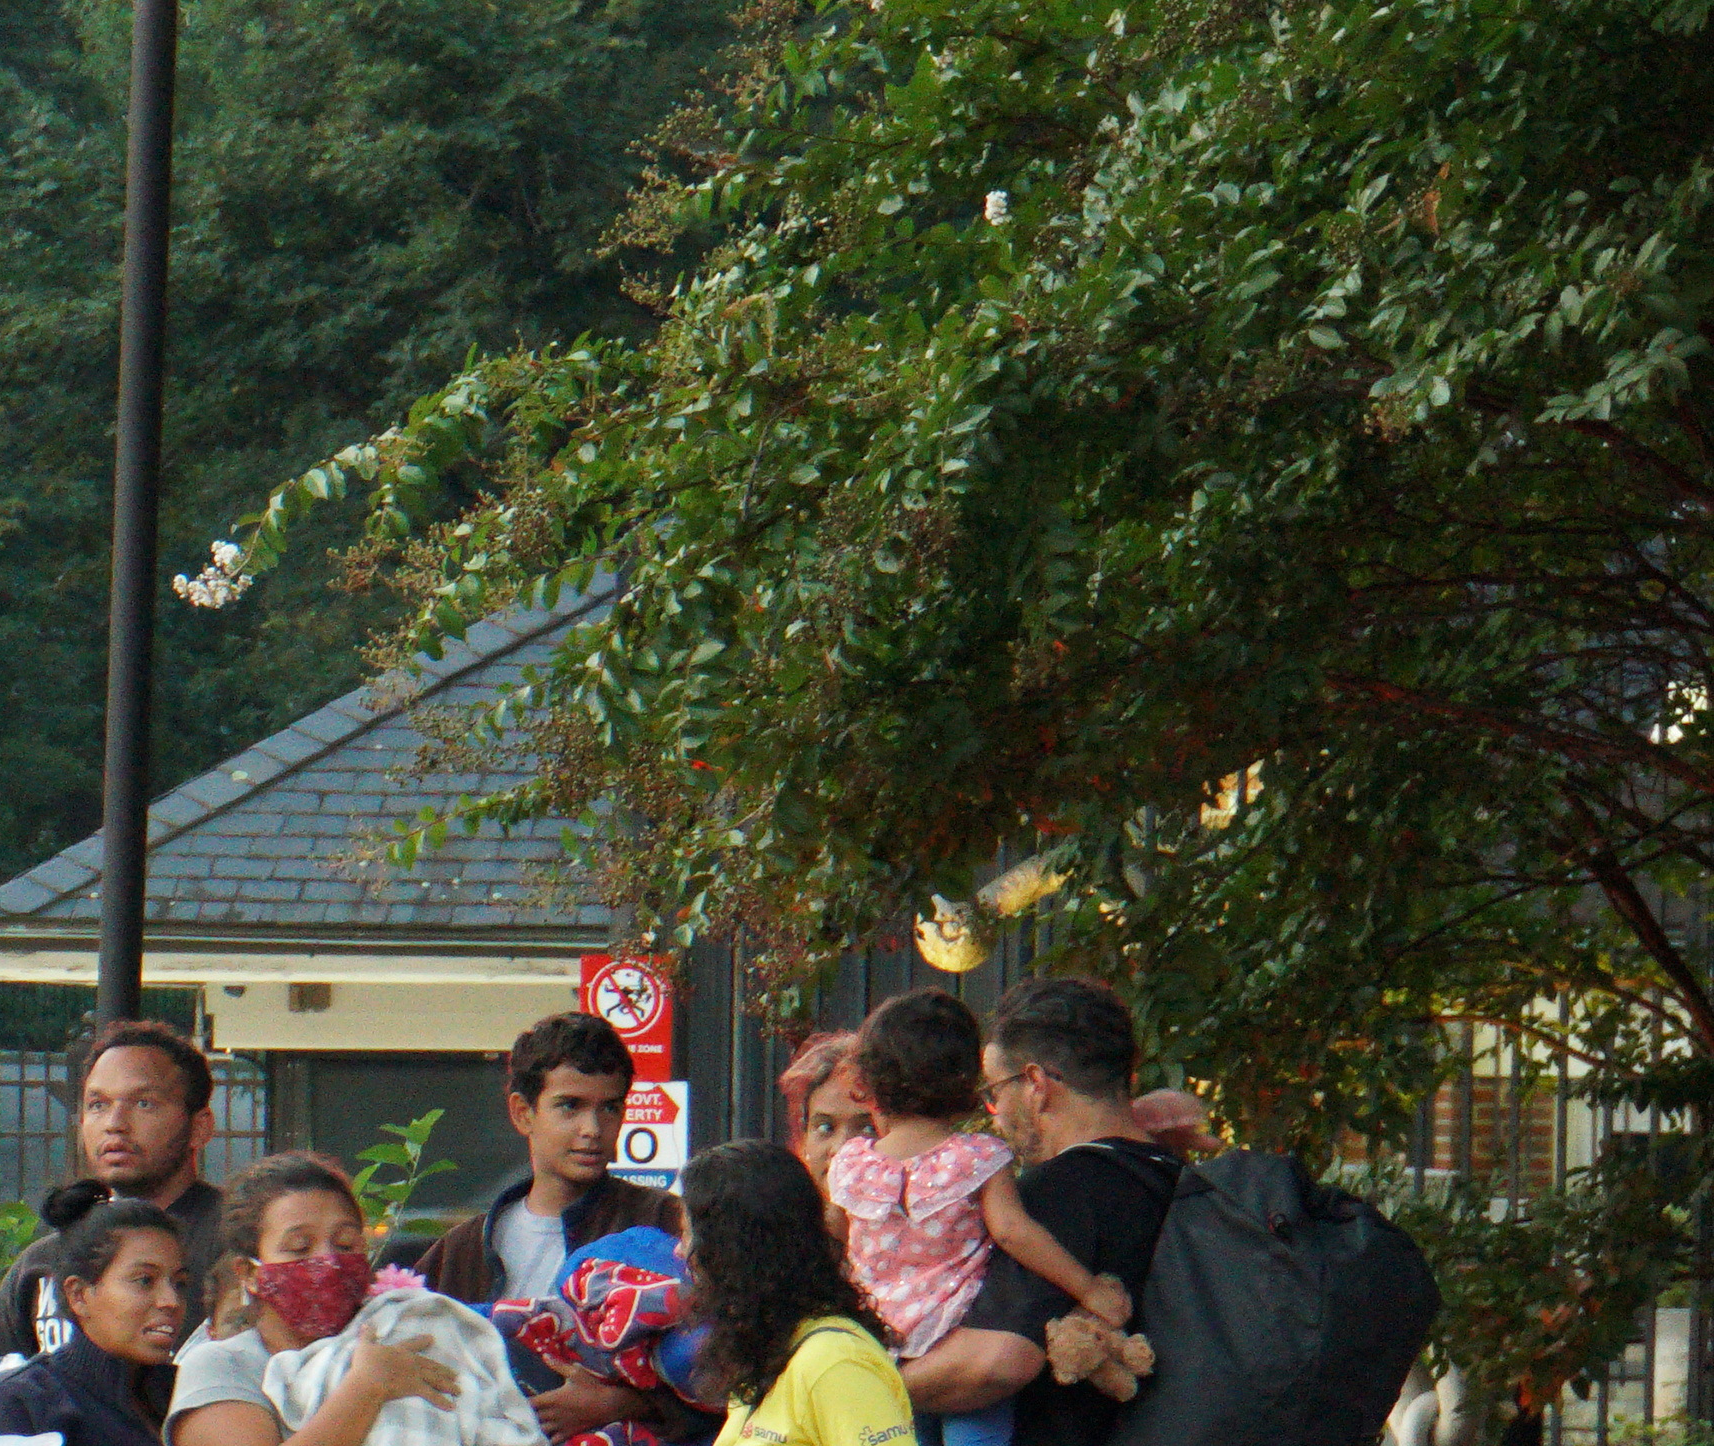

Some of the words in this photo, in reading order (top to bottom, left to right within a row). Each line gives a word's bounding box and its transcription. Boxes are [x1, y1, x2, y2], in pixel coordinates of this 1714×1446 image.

[624, 1127, 658, 1164] O
[754, 1426, 787, 1444] samu
[868, 1424, 908, 1446] samu
